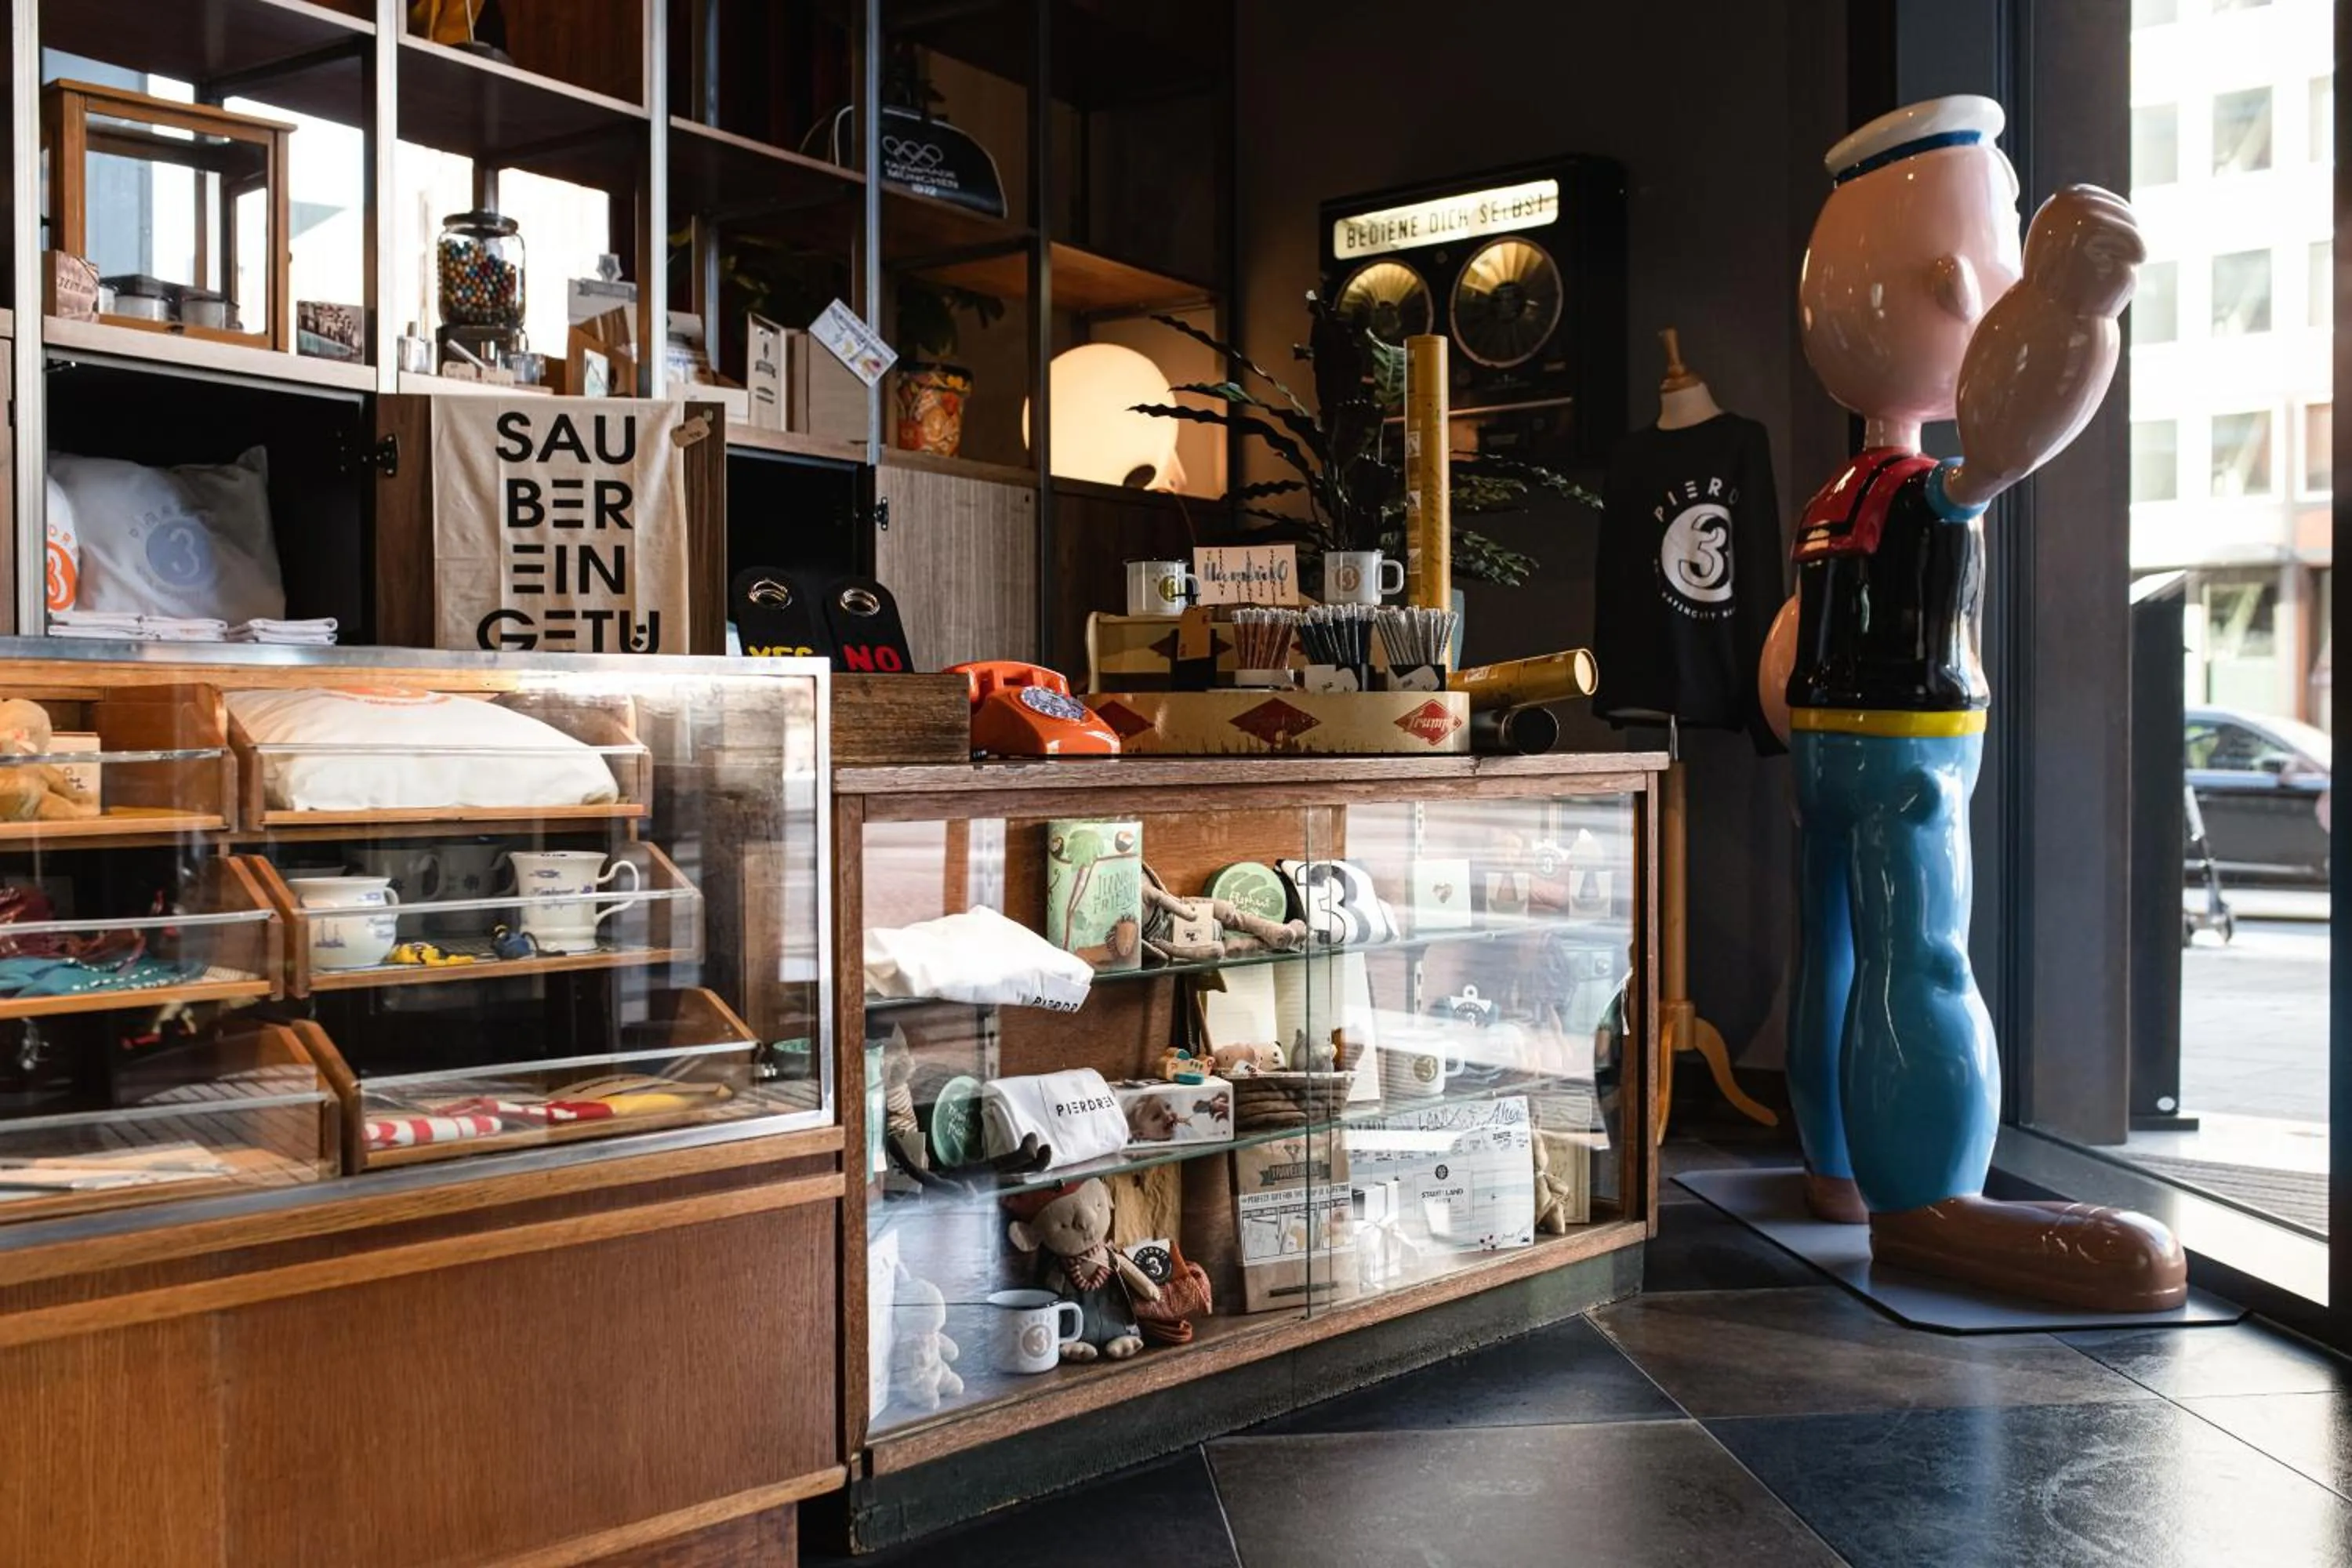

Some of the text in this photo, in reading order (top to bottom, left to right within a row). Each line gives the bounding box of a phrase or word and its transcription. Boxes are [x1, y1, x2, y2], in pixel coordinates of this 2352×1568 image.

[1346, 216, 1418, 249] BEDIENE
[1429, 207, 1468, 234] DICH
[495, 412, 636, 465] SAU
[506, 478, 633, 529] BER
[512, 543, 626, 595] EIN
[1678, 512, 1730, 590] 3
[843, 644, 902, 672] NO
[1056, 1097, 1114, 1117] PIERDREI
[1145, 1257, 1163, 1276] 3
